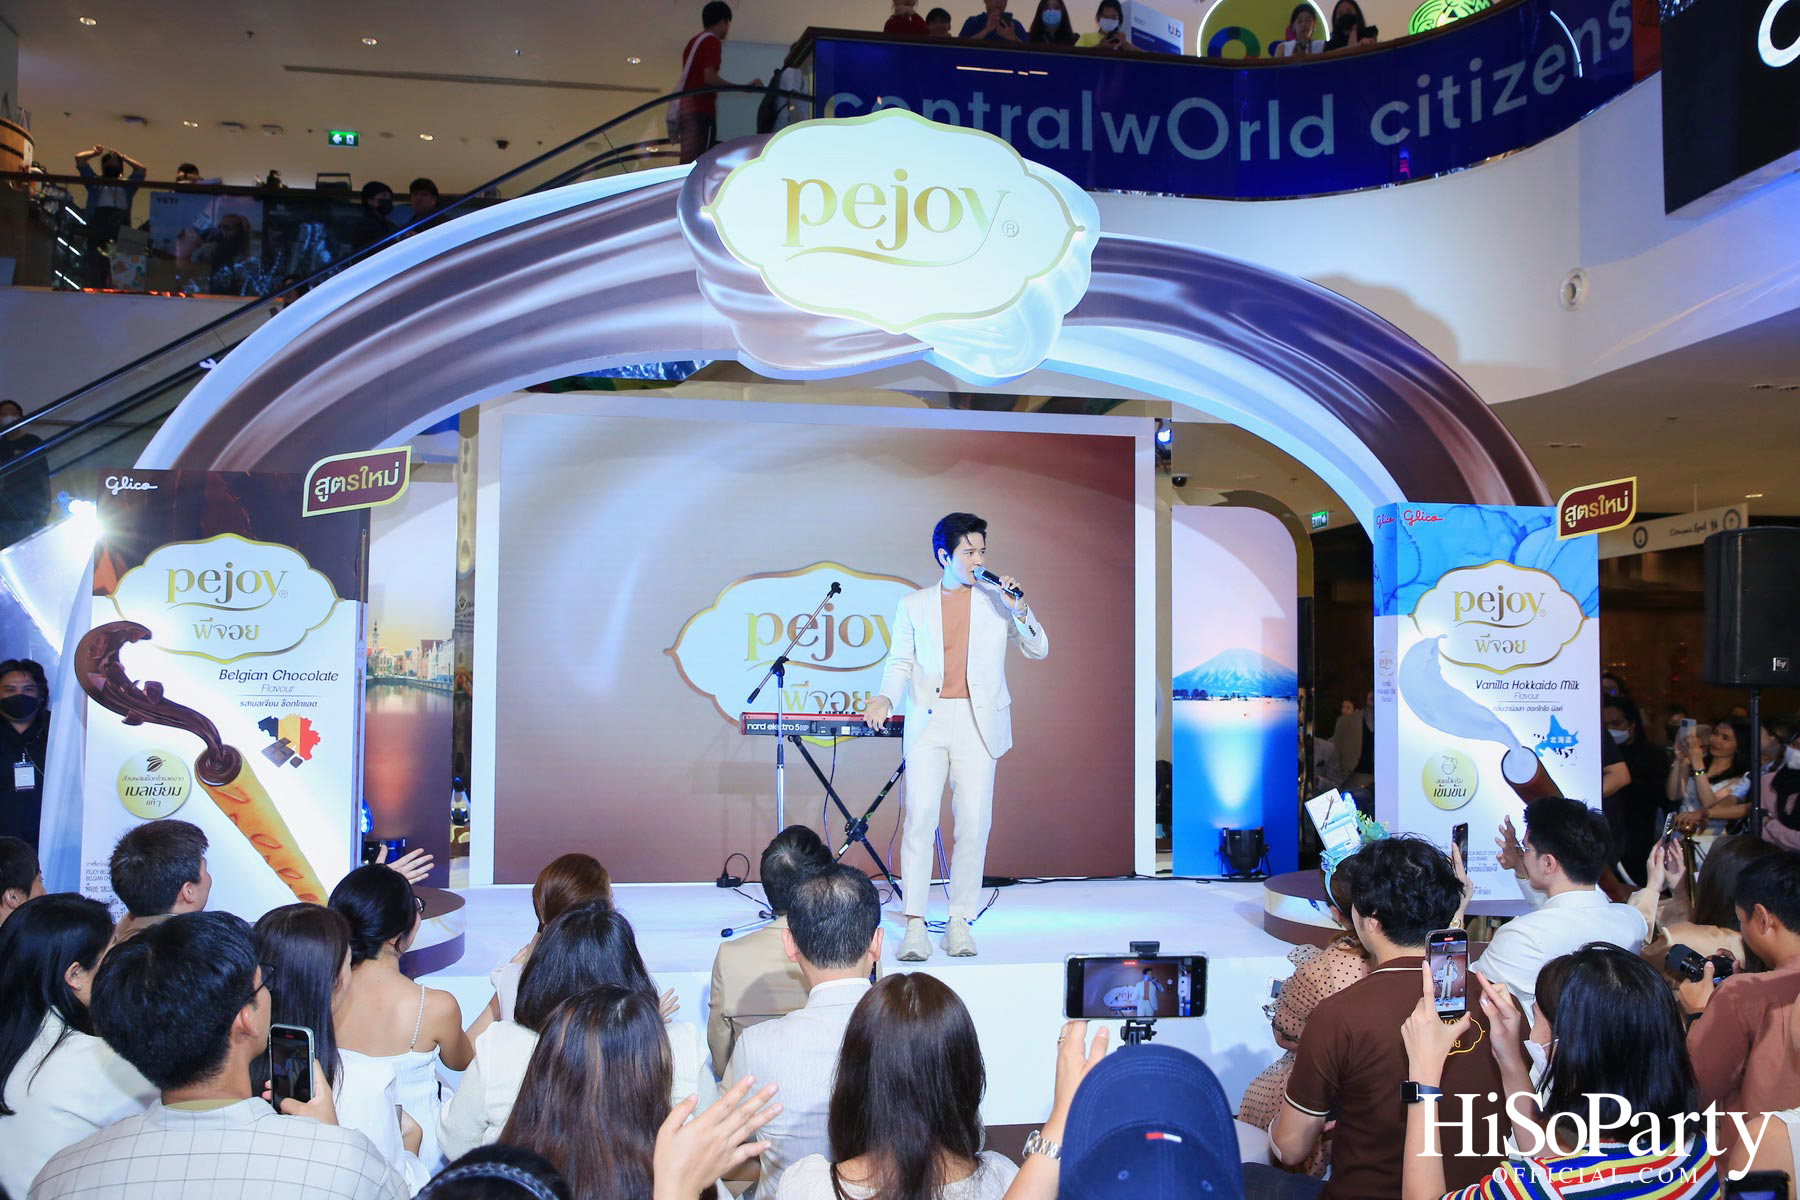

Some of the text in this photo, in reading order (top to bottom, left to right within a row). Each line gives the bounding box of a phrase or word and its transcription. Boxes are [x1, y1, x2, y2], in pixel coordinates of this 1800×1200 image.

[1370, 0, 1632, 146] citizens
[781, 168, 1011, 267] pejoy
[105, 476, 158, 495] Glico
[315, 461, 400, 502] สูตรใหม่
[1403, 509, 1444, 526] Glico
[1564, 490, 1629, 528] สูตรใหม่
[165, 562, 288, 611] pejoy
[1453, 585, 1546, 628] pejoy
[192, 617, 260, 640] พีจอย
[1475, 633, 1527, 654] พีจอย
[218, 669, 339, 683] Belgian Chocolate
[1476, 680, 1580, 690] Vanilla Hokkaido Milk
[261, 683, 296, 693] Flavour
[1513, 691, 1540, 700] Flavour
[747, 723, 766, 731] nord
[125, 782, 182, 797] เบลเยียม
